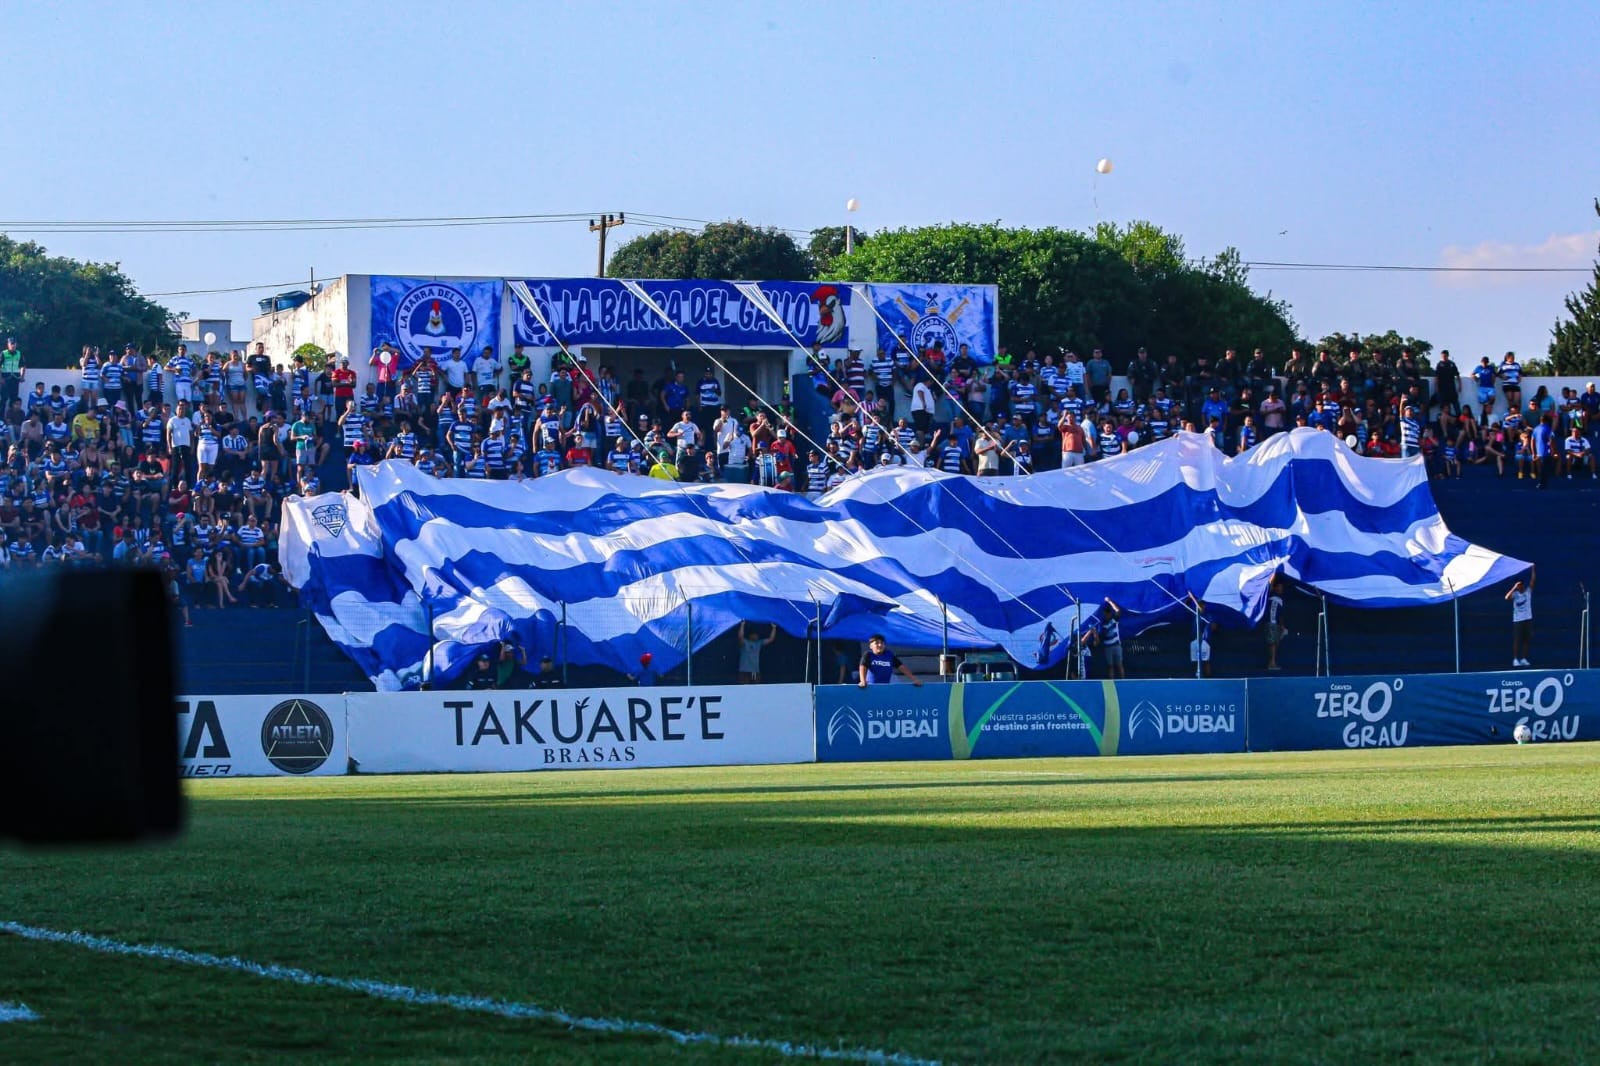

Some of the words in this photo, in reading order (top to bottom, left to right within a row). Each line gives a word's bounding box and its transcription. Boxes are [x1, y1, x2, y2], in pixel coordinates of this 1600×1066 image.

[403, 288, 435, 313] BARRA
[438, 288, 455, 302] DEL
[455, 300, 473, 333] GALLO
[562, 287, 594, 336] LA
[599, 288, 683, 333] BARRA
[689, 287, 732, 329] DEL
[400, 315, 409, 330] LA
[867, 708, 939, 719] SHOPPING
[1166, 704, 1236, 713] SHOPPING
[989, 713, 1024, 721] Nuestra
[1026, 711, 1055, 723] pasión
[1056, 713, 1068, 721] es
[1166, 714, 1236, 733] DUBAI
[271, 725, 321, 739] ATLETA
[867, 718, 939, 739] DUBAI
[993, 721, 1028, 731] destino
[1030, 721, 1045, 730] sin
[1047, 720, 1091, 730] fronteras
[1342, 721, 1408, 748] GRAU
[543, 746, 636, 764] BRASAS
